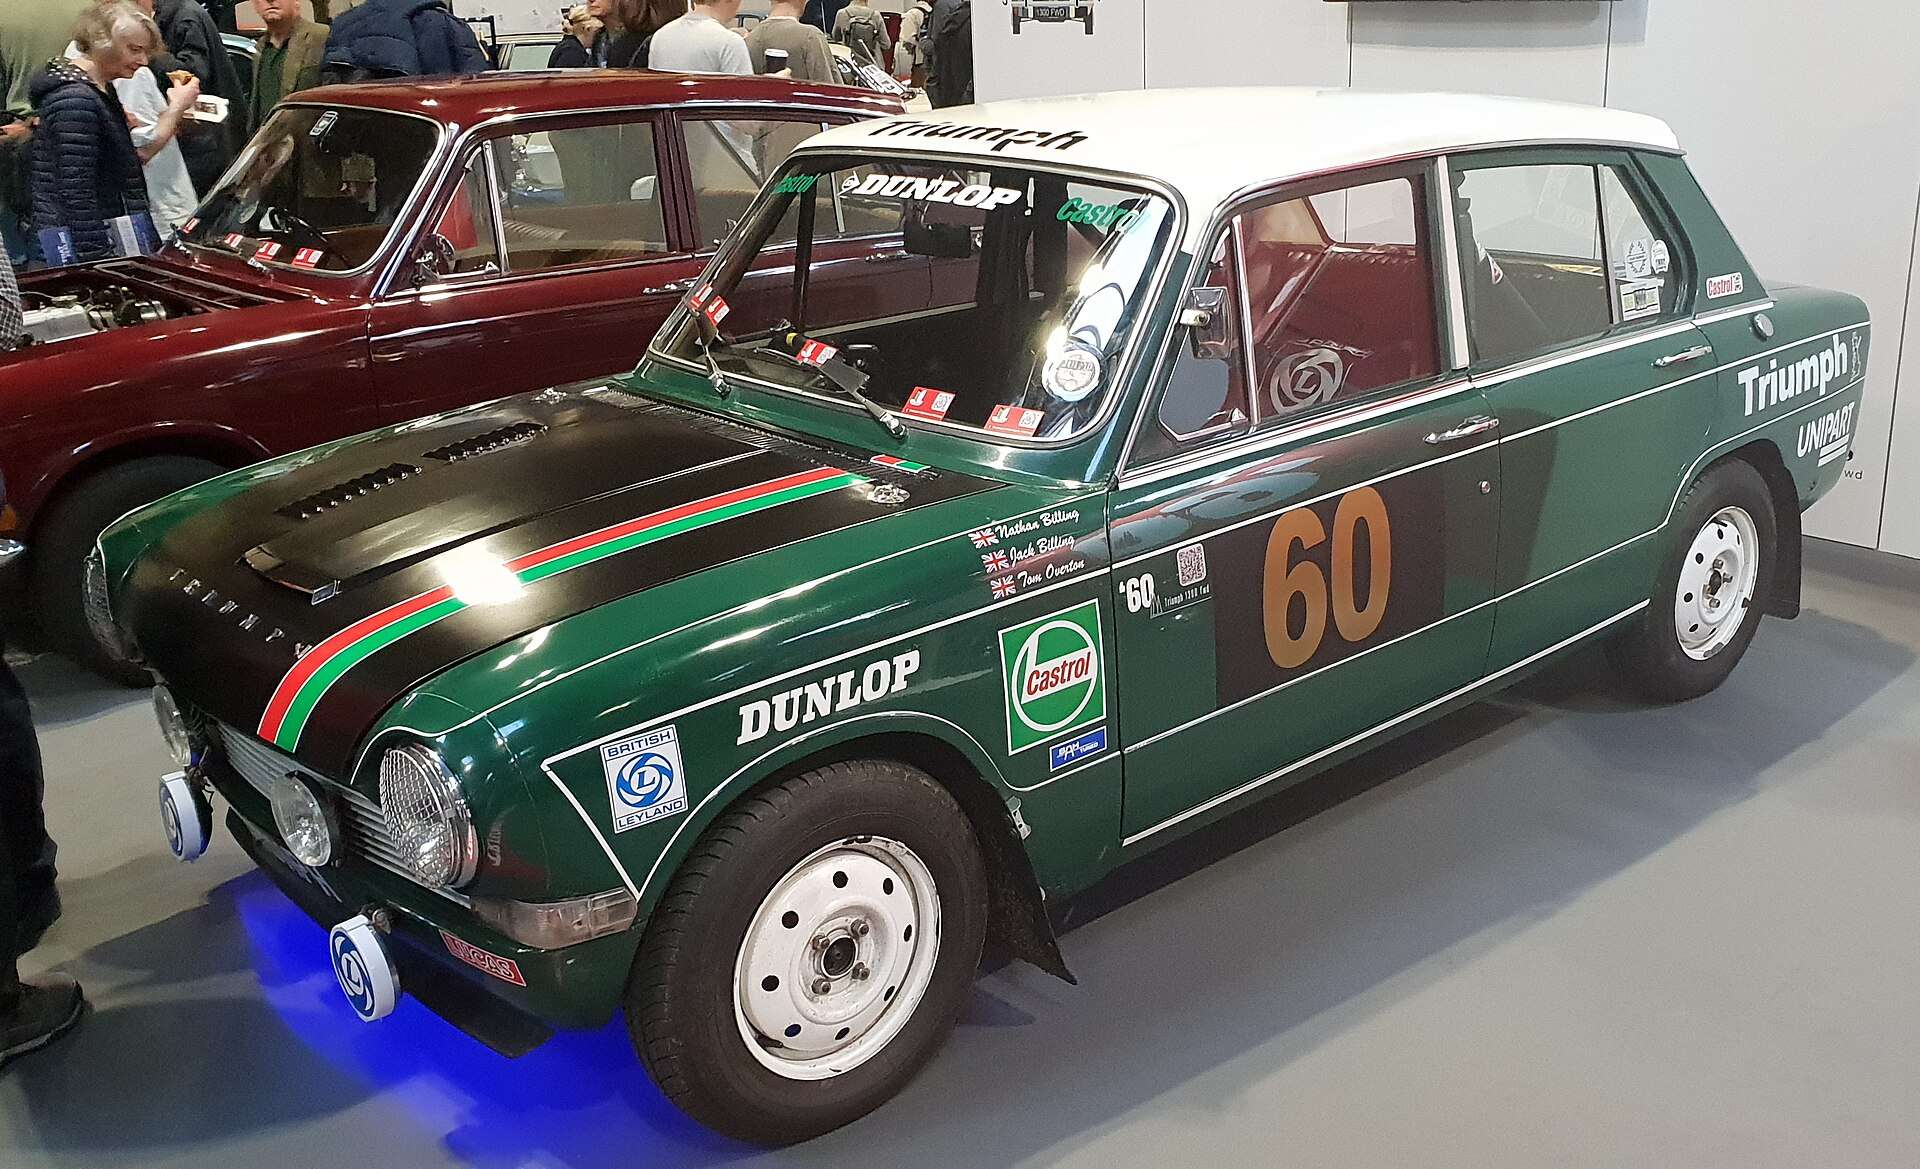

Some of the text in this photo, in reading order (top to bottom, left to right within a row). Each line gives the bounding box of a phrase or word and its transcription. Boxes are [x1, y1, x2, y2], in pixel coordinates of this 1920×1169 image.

[1050, 8, 1065, 17] FWD
[868, 121, 1088, 152] Triumph
[851, 174, 1022, 210] DUNLOP
[1708, 276, 1733, 297] Castrol
[1737, 333, 1848, 417] Triumph
[1797, 401, 1856, 458] UNIPART
[994, 509, 1080, 539] Nathan Billing
[1009, 535, 1076, 568] Jack Billing
[1017, 559, 1086, 588] Tom Overton
[1263, 486, 1392, 669] 60
[1026, 651, 1092, 696] Castrol
[737, 650, 920, 746] DUNLOP
[608, 731, 671, 757] BRITISH
[619, 800, 683, 828] LEYLAND
[443, 934, 515, 980] LUCAS
